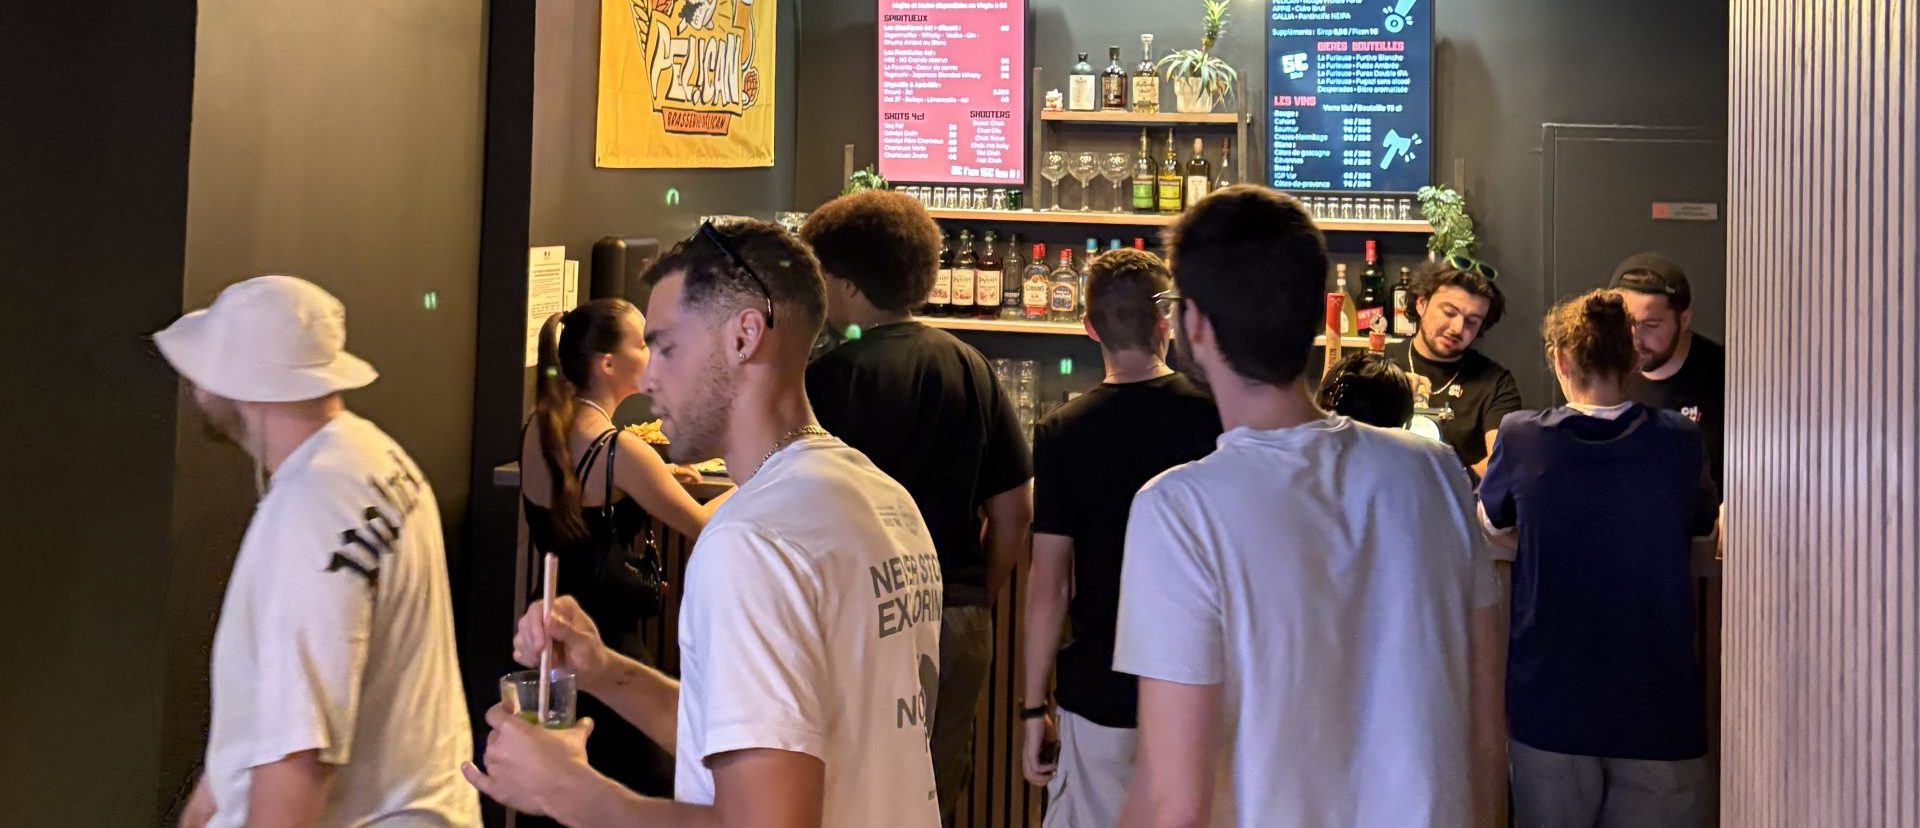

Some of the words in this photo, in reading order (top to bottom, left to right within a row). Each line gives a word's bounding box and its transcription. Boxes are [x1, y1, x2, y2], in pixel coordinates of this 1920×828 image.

[883, 14, 927, 22] SPIRITUEUX
[1317, 41, 1348, 52] BIERES
[1352, 41, 1404, 51] BOUTEILLES
[1282, 52, 1308, 74] 5€
[1274, 96, 1292, 106] LES
[1294, 96, 1316, 106] VINS
[884, 112, 909, 120] SHOTS
[970, 110, 1010, 119] SHOOTERS
[919, 553, 941, 584] STO
